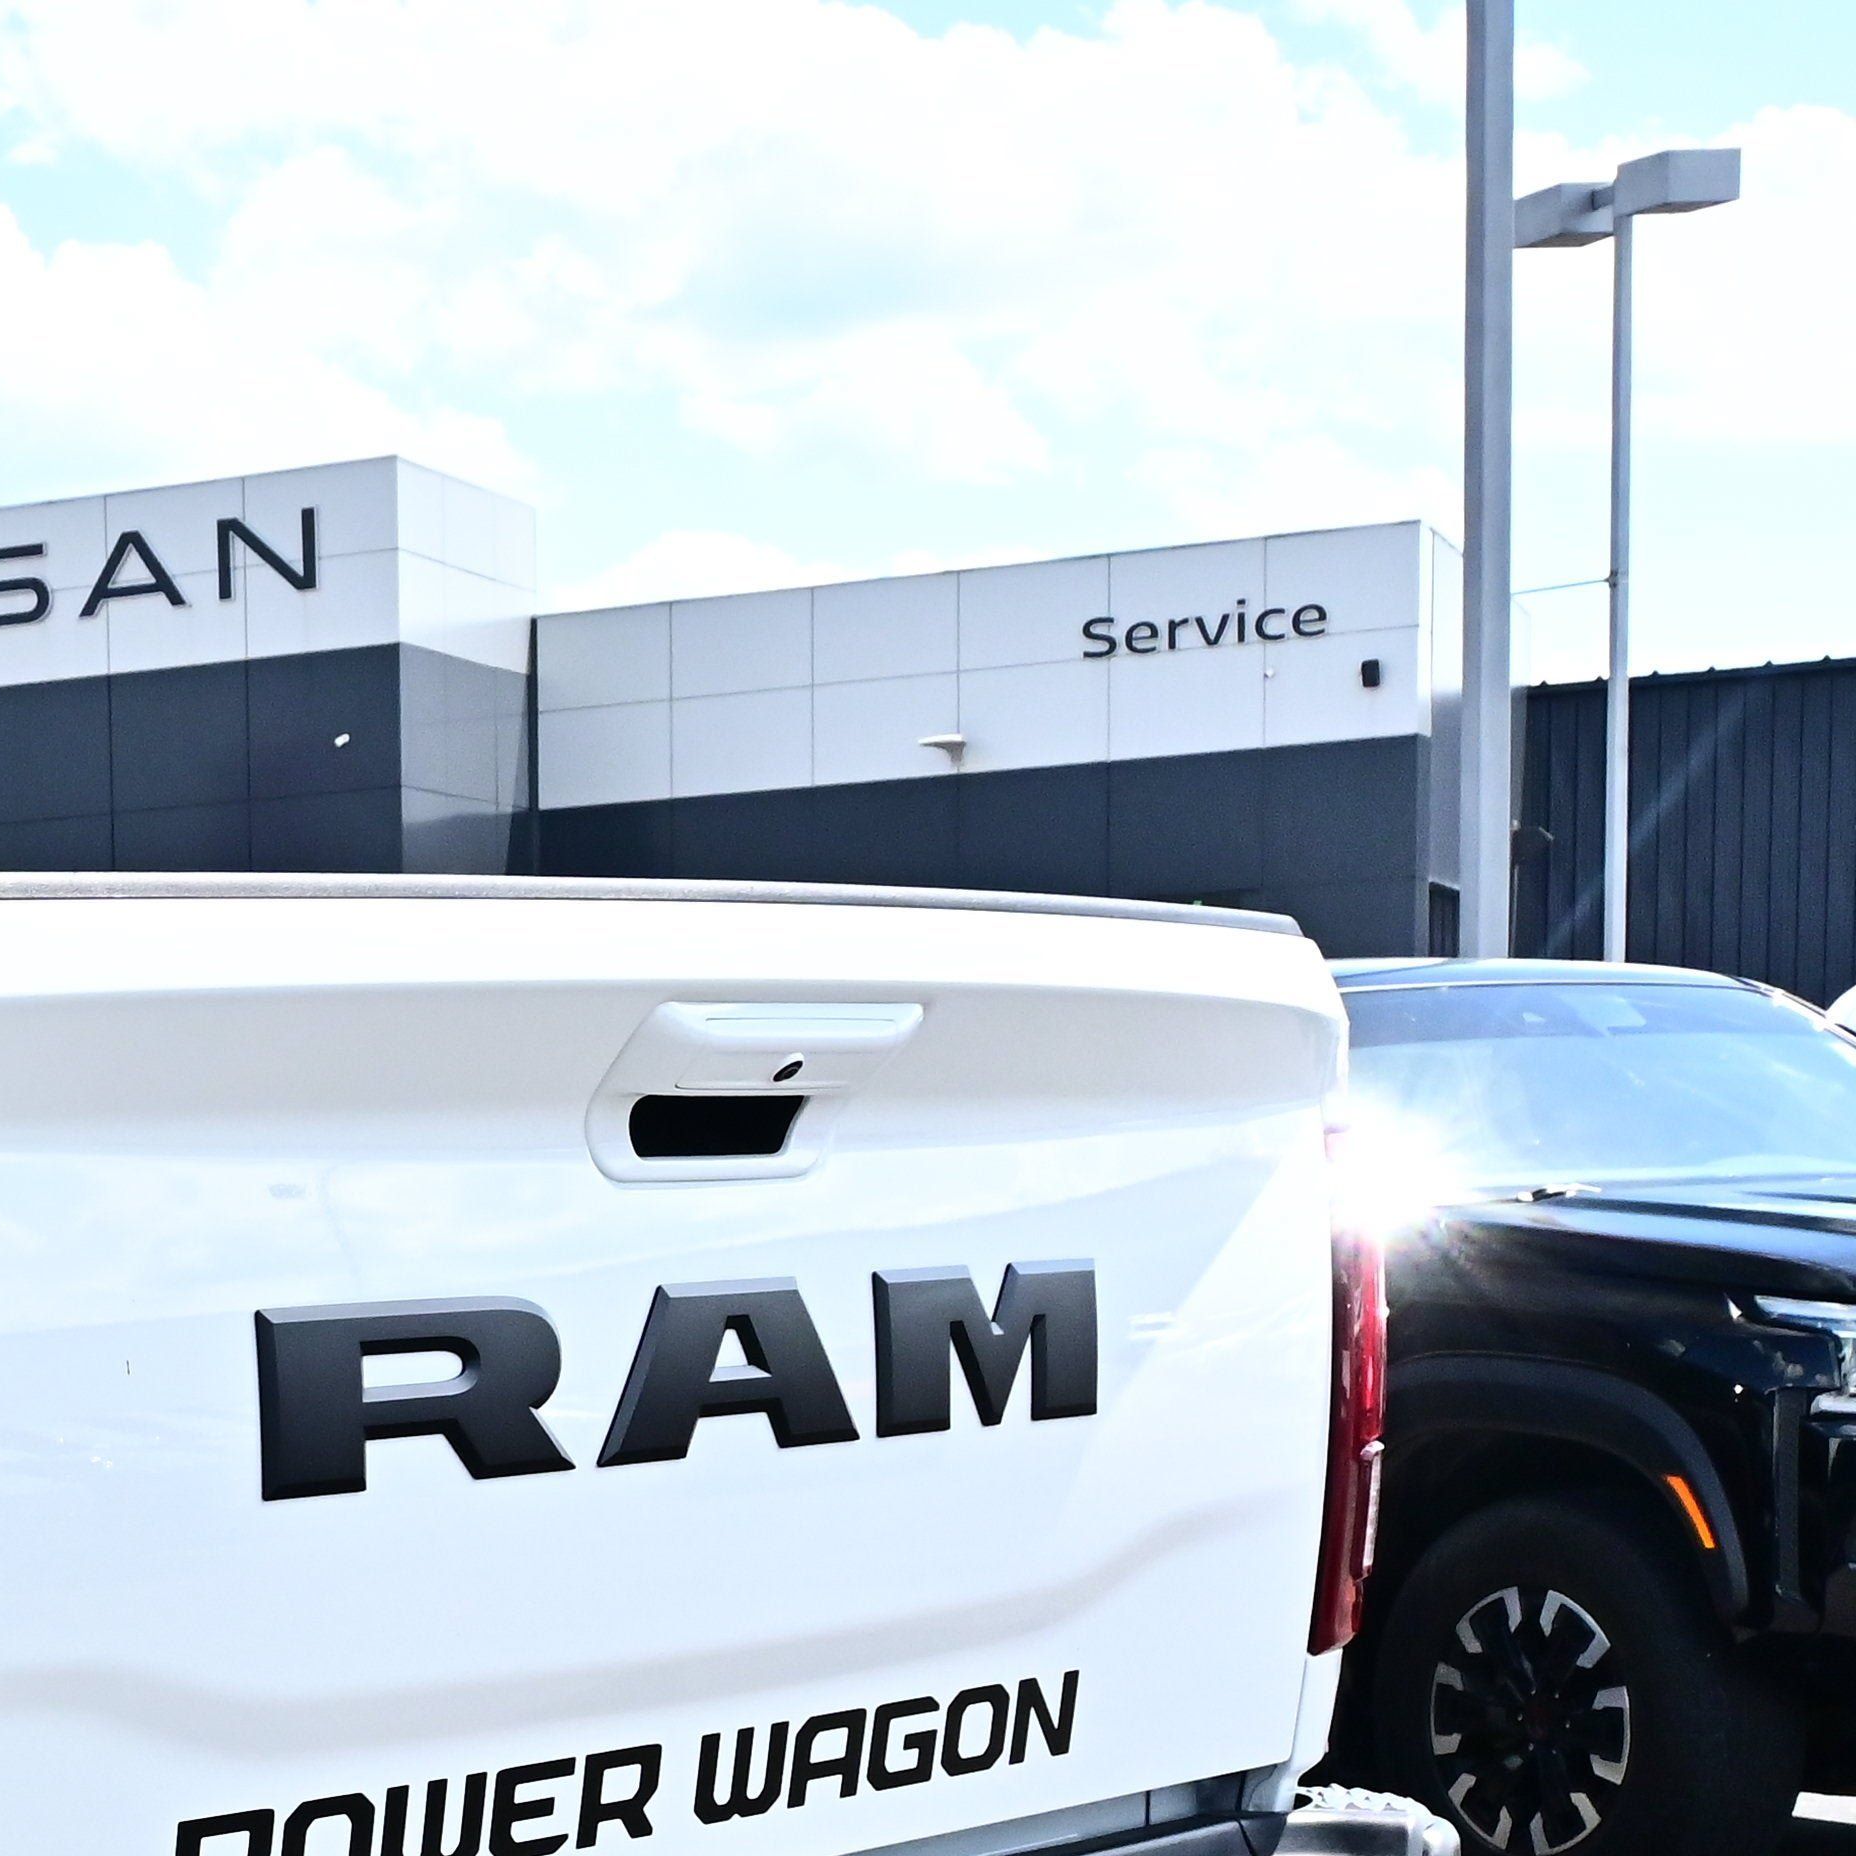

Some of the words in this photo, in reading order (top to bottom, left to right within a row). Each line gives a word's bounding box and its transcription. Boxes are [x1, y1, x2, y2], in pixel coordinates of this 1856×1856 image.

[1082, 598, 1328, 659] Service
[254, 1257, 1098, 1502] RAM
[692, 1669, 1080, 1826] WAGON
